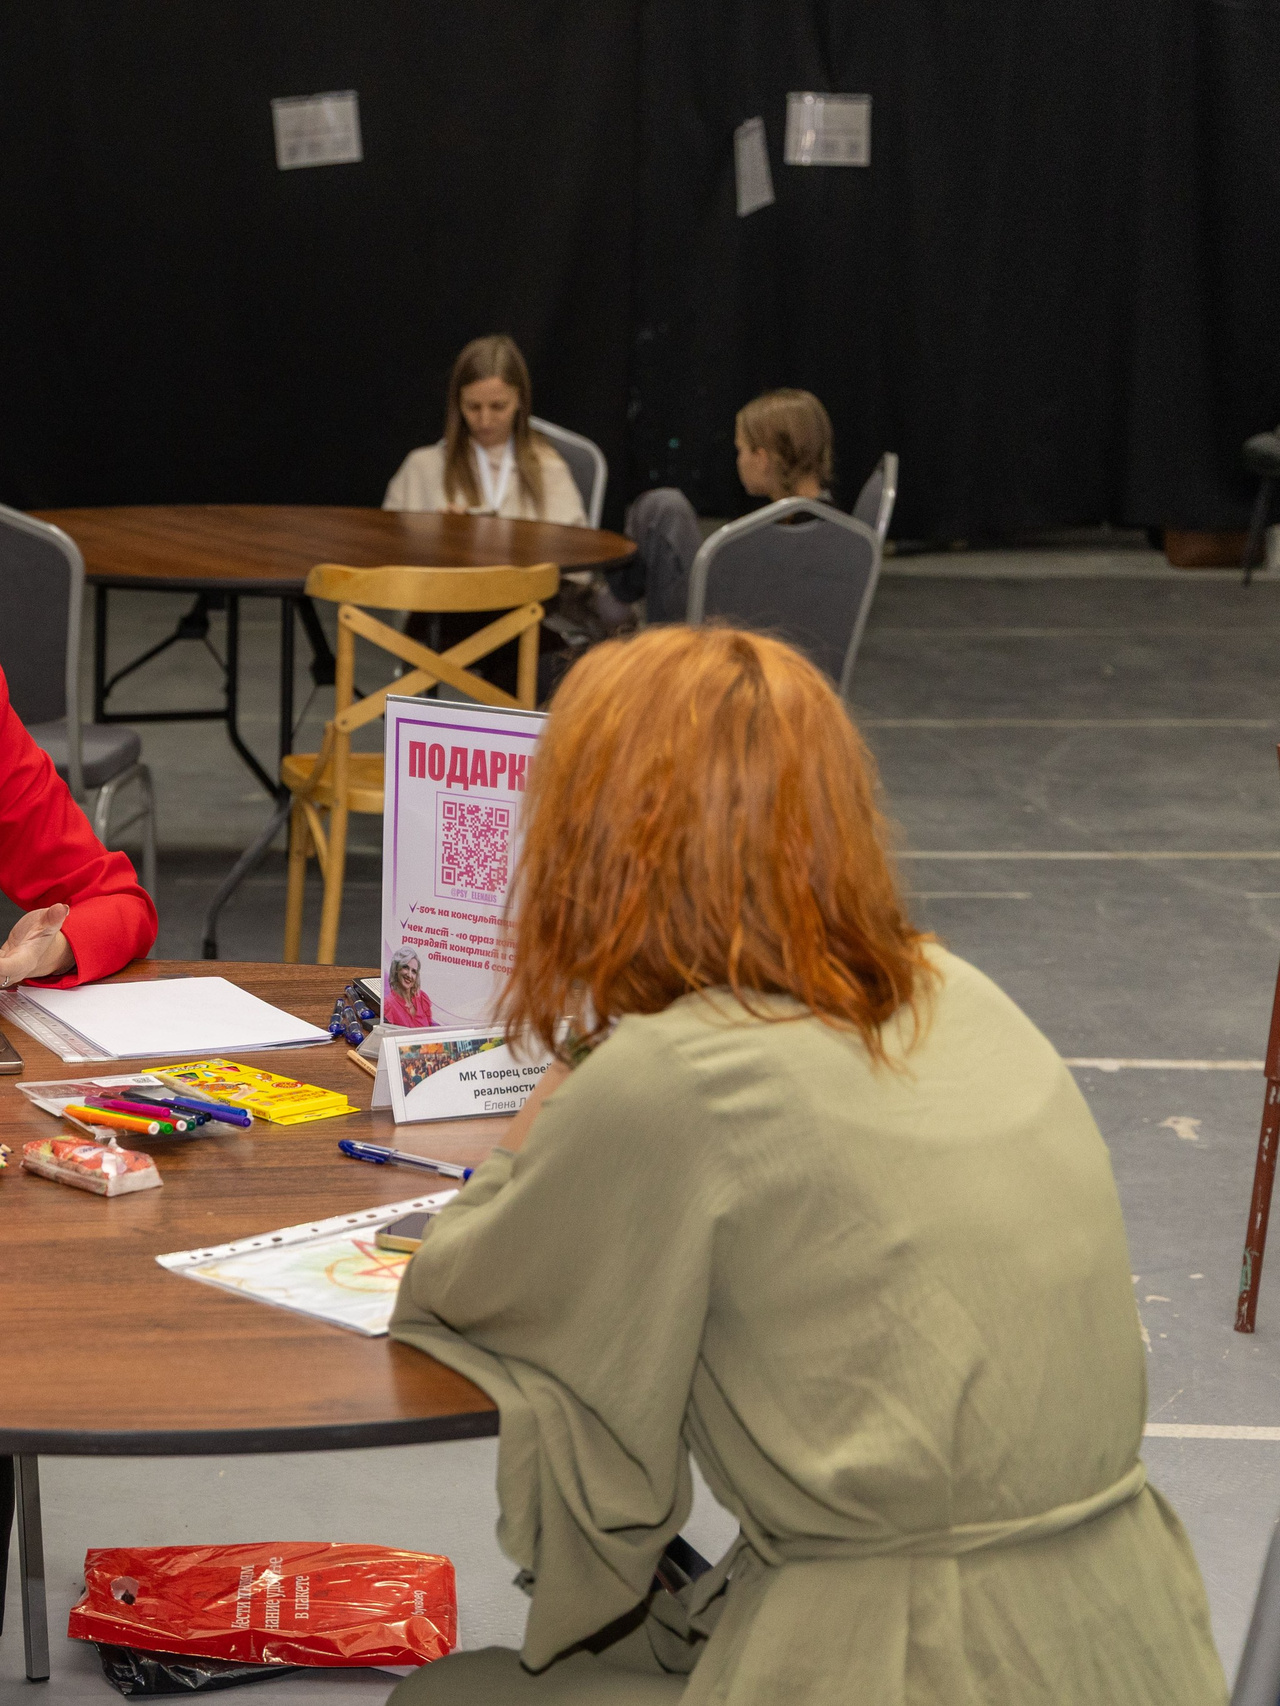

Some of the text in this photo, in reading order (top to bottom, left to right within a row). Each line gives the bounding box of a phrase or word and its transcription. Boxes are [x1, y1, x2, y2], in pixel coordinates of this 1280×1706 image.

[438, 907, 449, 917] на
[407, 923, 423, 932] чек
[424, 926, 449, 937] лист
[469, 933, 494, 945] фраз
[401, 935, 448, 950] разрядят
[449, 943, 499, 959] конфликт
[428, 951, 482, 969] отношения
[484, 961, 489, 970] в
[459, 1070, 478, 1082] МК
[479, 1068, 520, 1080] Творец
[474, 1083, 536, 1099] реальности
[484, 1100, 516, 1111] Елена
[295, 1575, 310, 1620] в пакете
